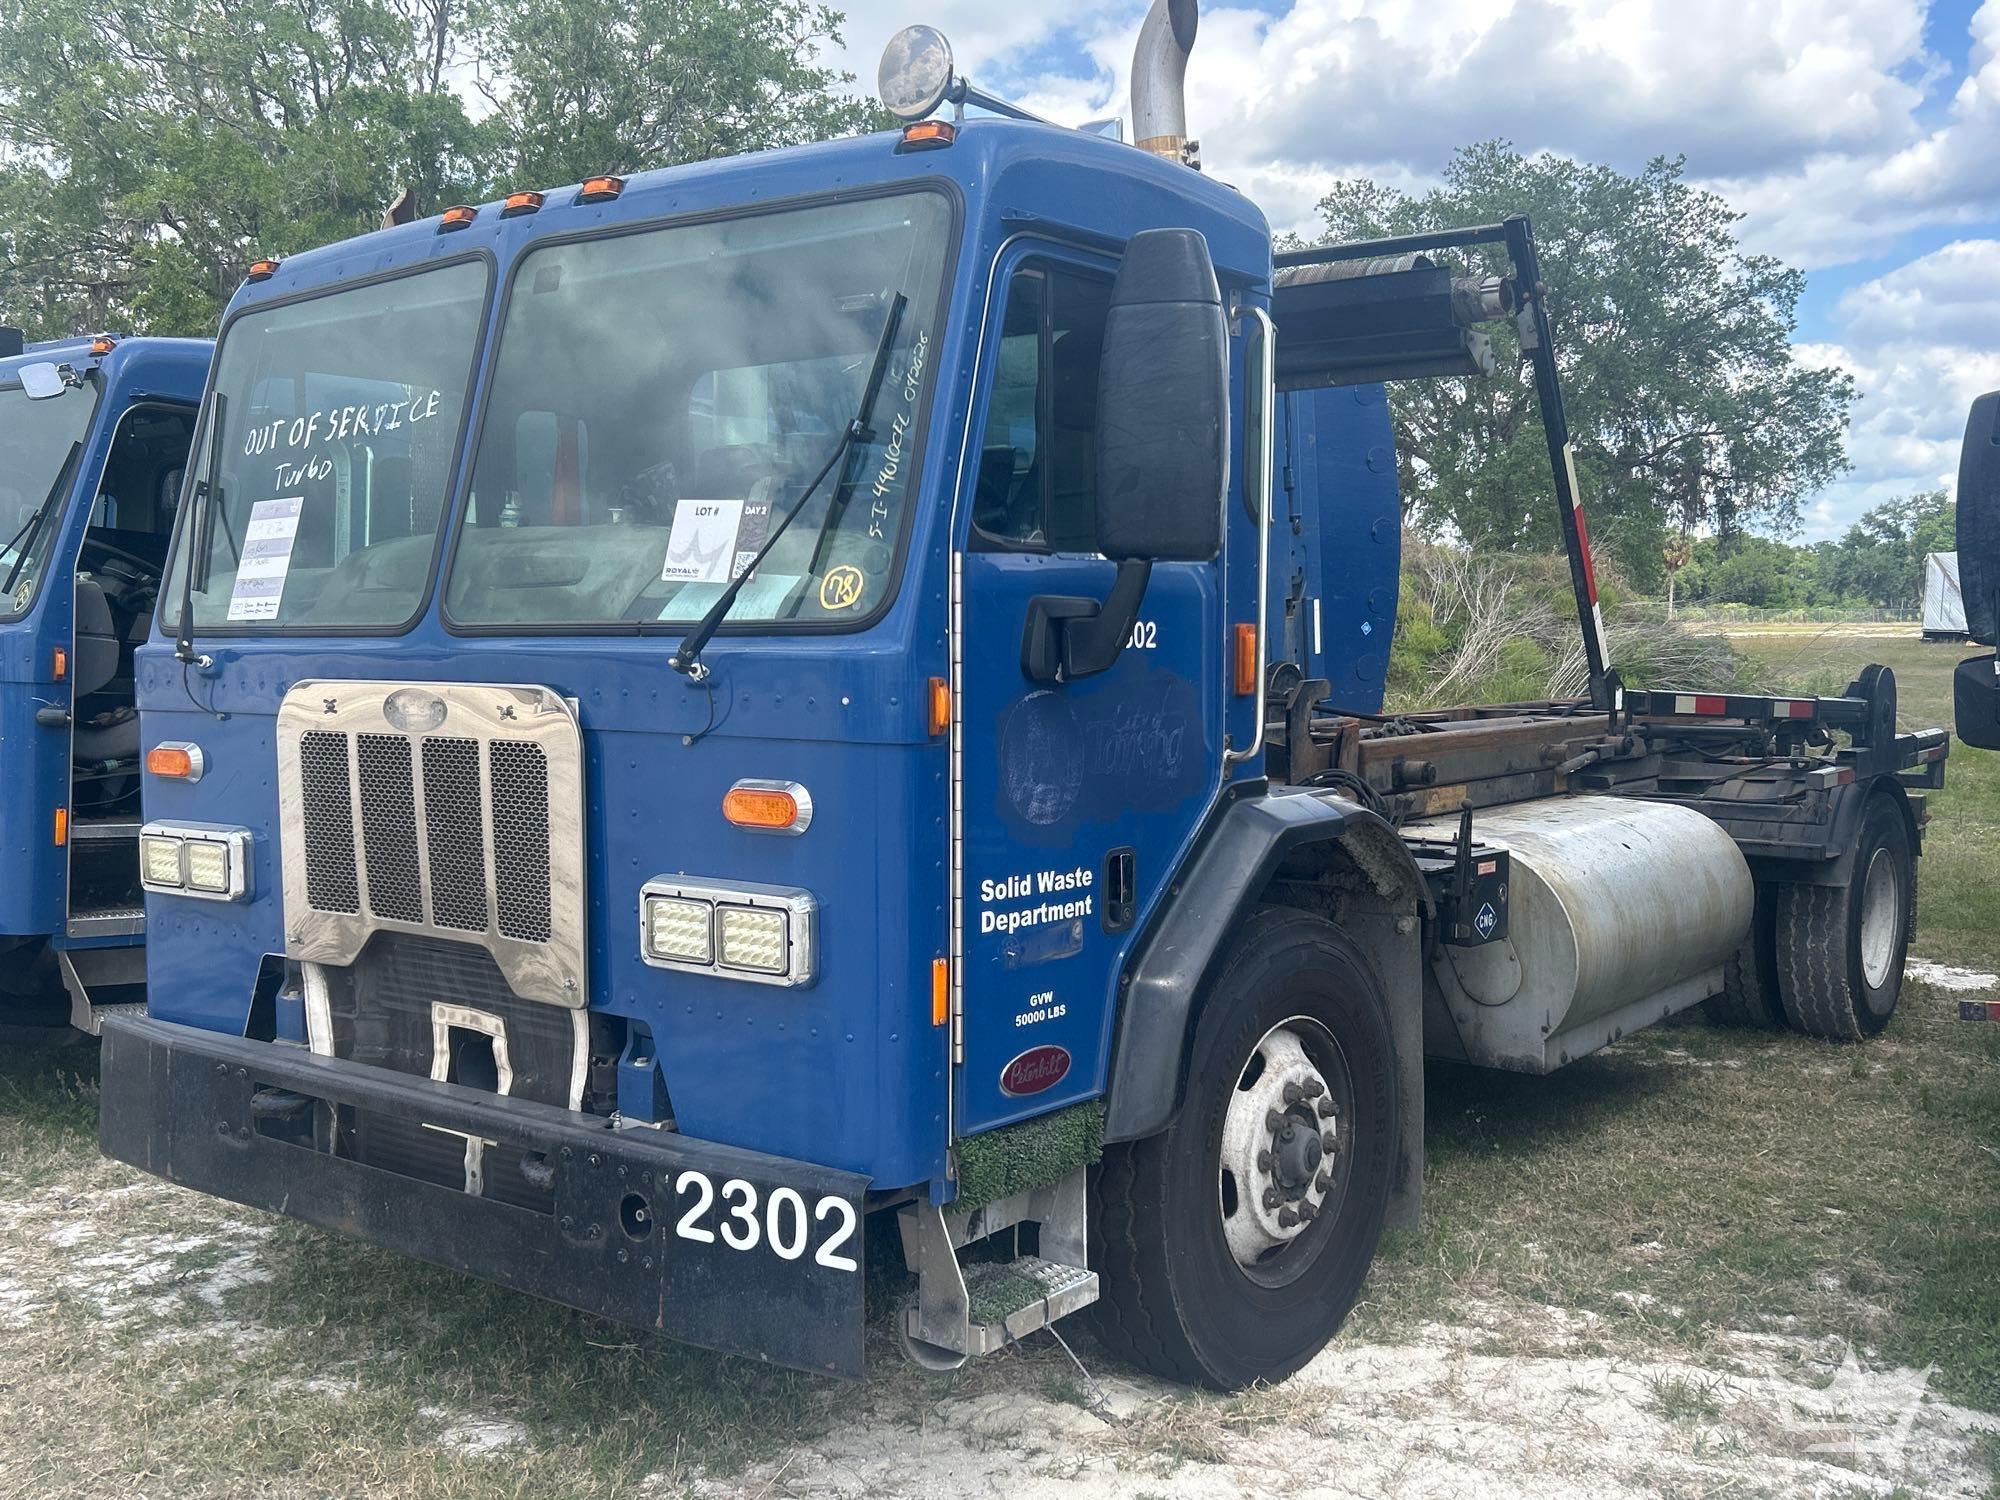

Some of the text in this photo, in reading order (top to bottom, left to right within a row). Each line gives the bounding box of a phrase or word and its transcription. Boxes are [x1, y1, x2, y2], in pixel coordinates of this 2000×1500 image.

[245, 390, 441, 456] OUT OF SERVICE
[695, 506, 712, 516] LOT
[745, 506, 761, 515] DAY
[980, 866, 1093, 902] Solid Waste
[981, 894, 1092, 935] Department
[1479, 914, 1493, 929] CNG
[1029, 991, 1053, 1007] GVW
[1015, 1004, 1066, 1027] 50000 LBS
[1010, 1053, 1067, 1089] Peterbilt
[675, 1170, 858, 1272] 2302
